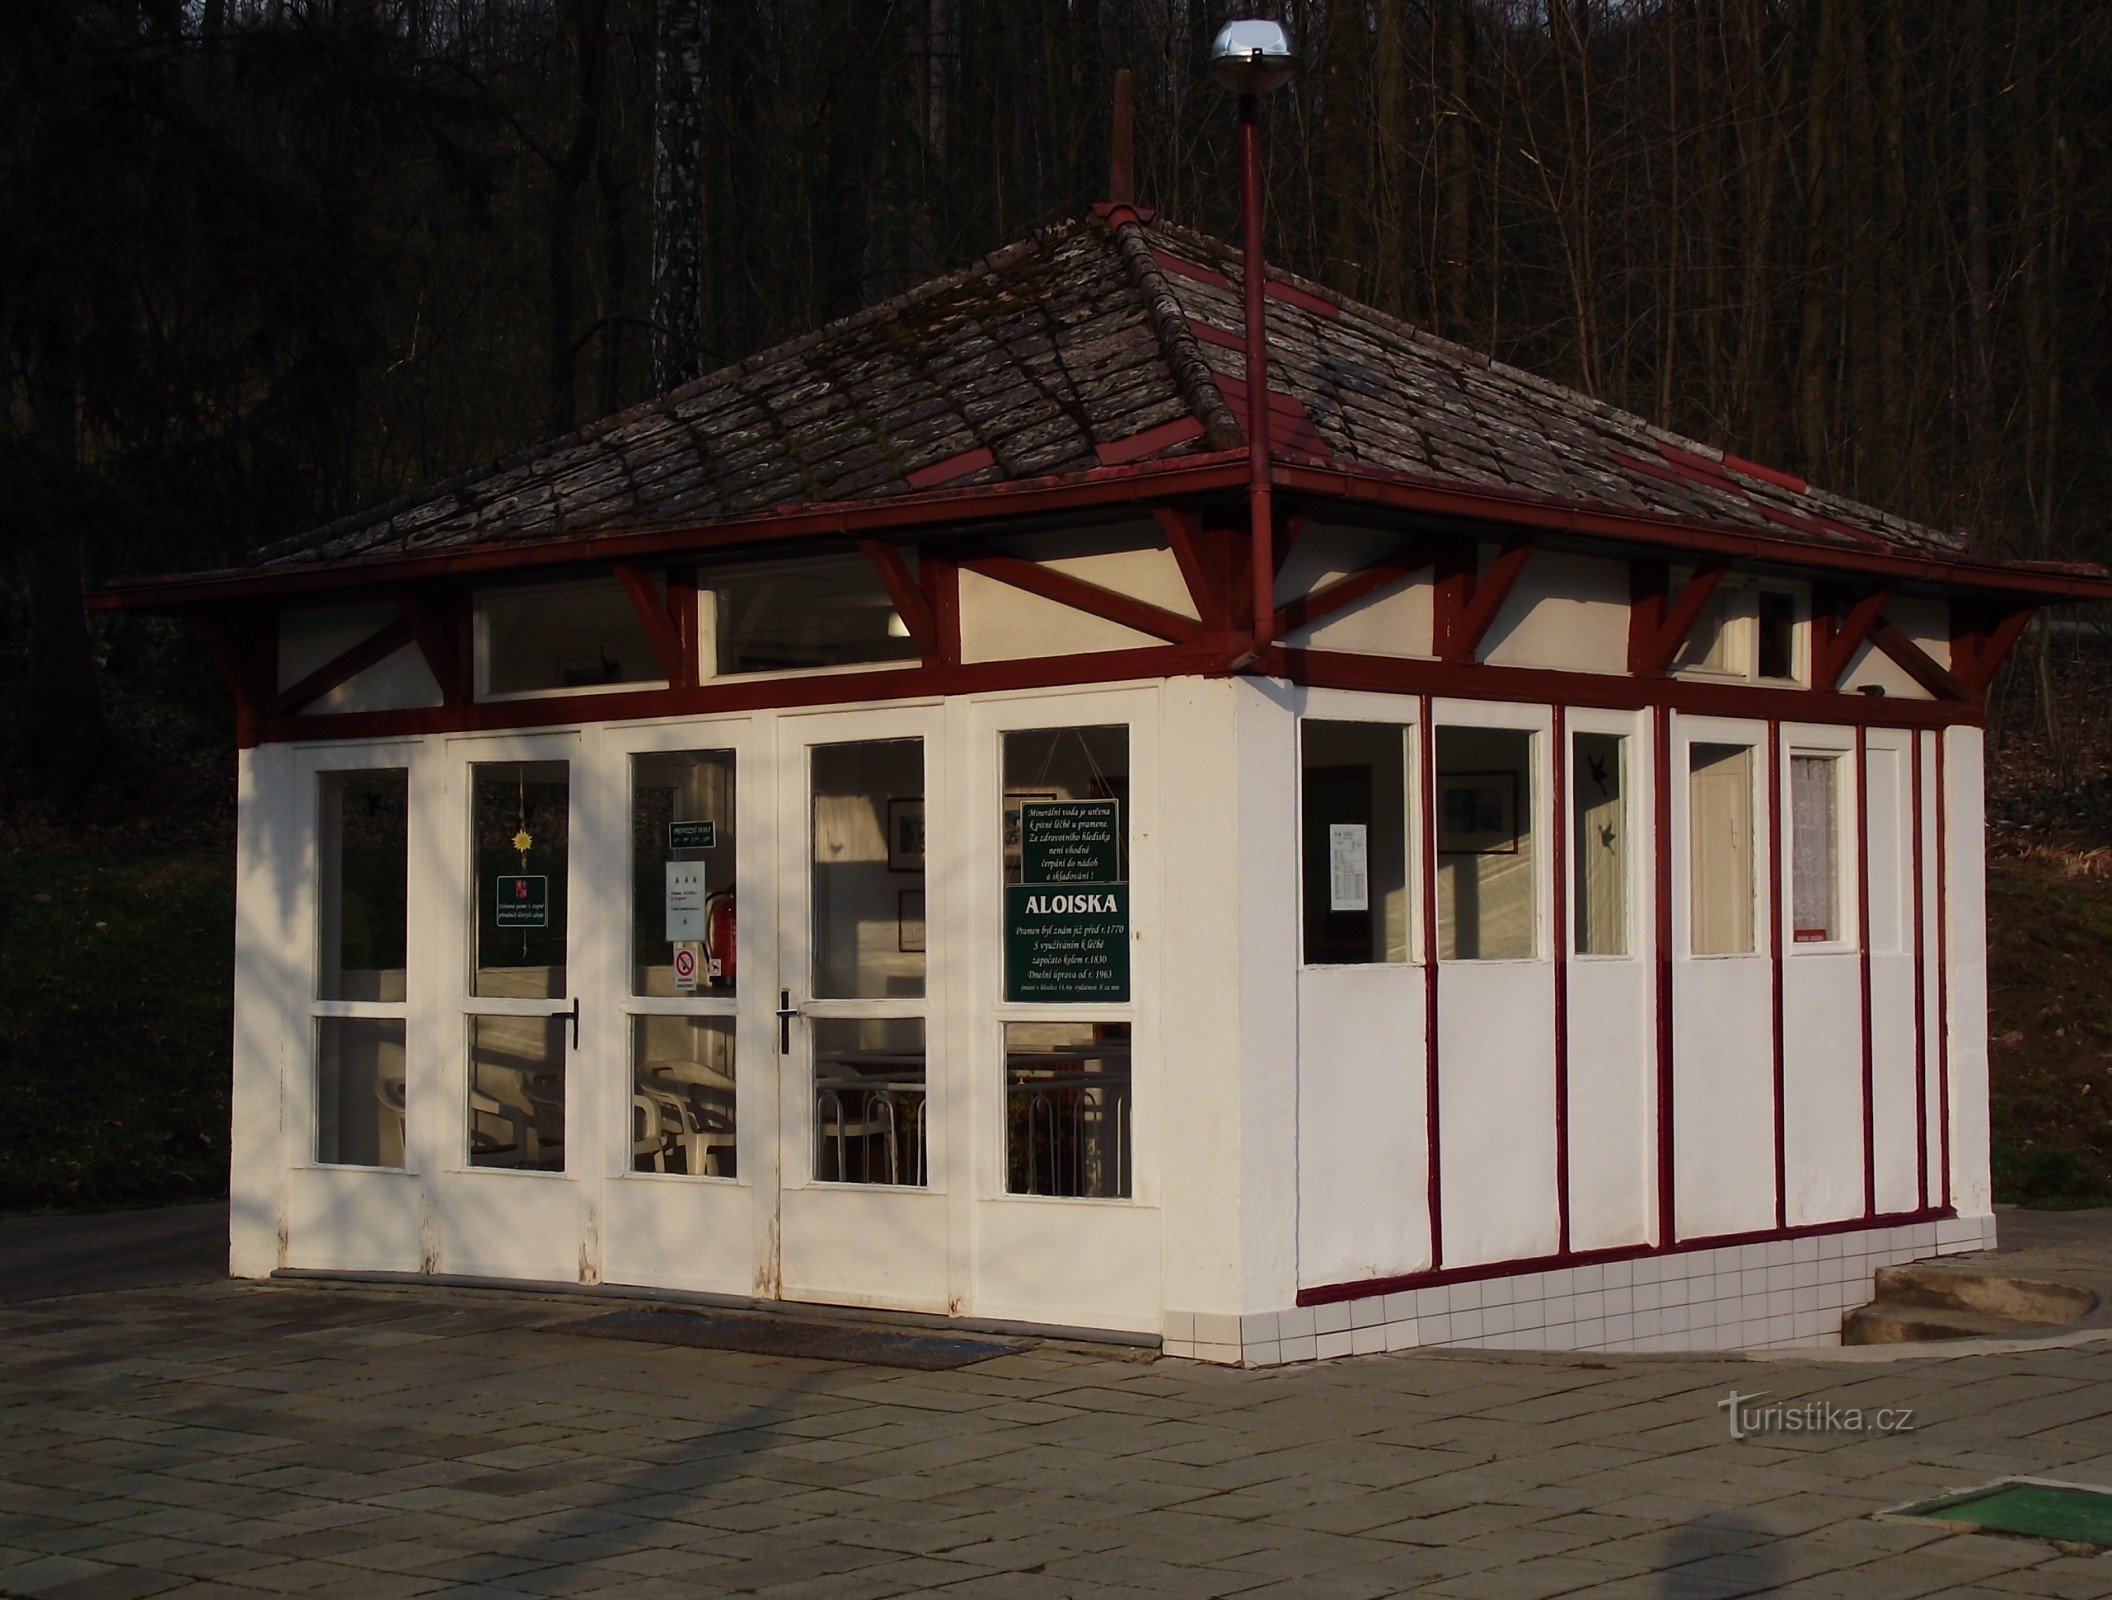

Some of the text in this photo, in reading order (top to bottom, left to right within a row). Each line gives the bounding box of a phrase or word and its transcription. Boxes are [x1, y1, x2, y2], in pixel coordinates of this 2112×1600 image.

[1062, 807, 1078, 816] voda
[1079, 808, 1086, 818] je
[1088, 807, 1110, 816] určena
[1078, 821, 1109, 831] pramene.
[1029, 831, 1110, 842] Ze zdravotního hlediska
[1049, 845, 1090, 854] není vhodné
[1067, 857, 1076, 867] do
[1077, 857, 1098, 867] nádob
[1052, 870, 1089, 881] skladování
[1025, 894, 1118, 914] ALOISKA
[1042, 925, 1054, 937] byl
[1033, 941, 1039, 950] S
[1064, 954, 1082, 965] kolem
[1078, 969, 1088, 979] od
[1096, 970, 1112, 979] 1963
